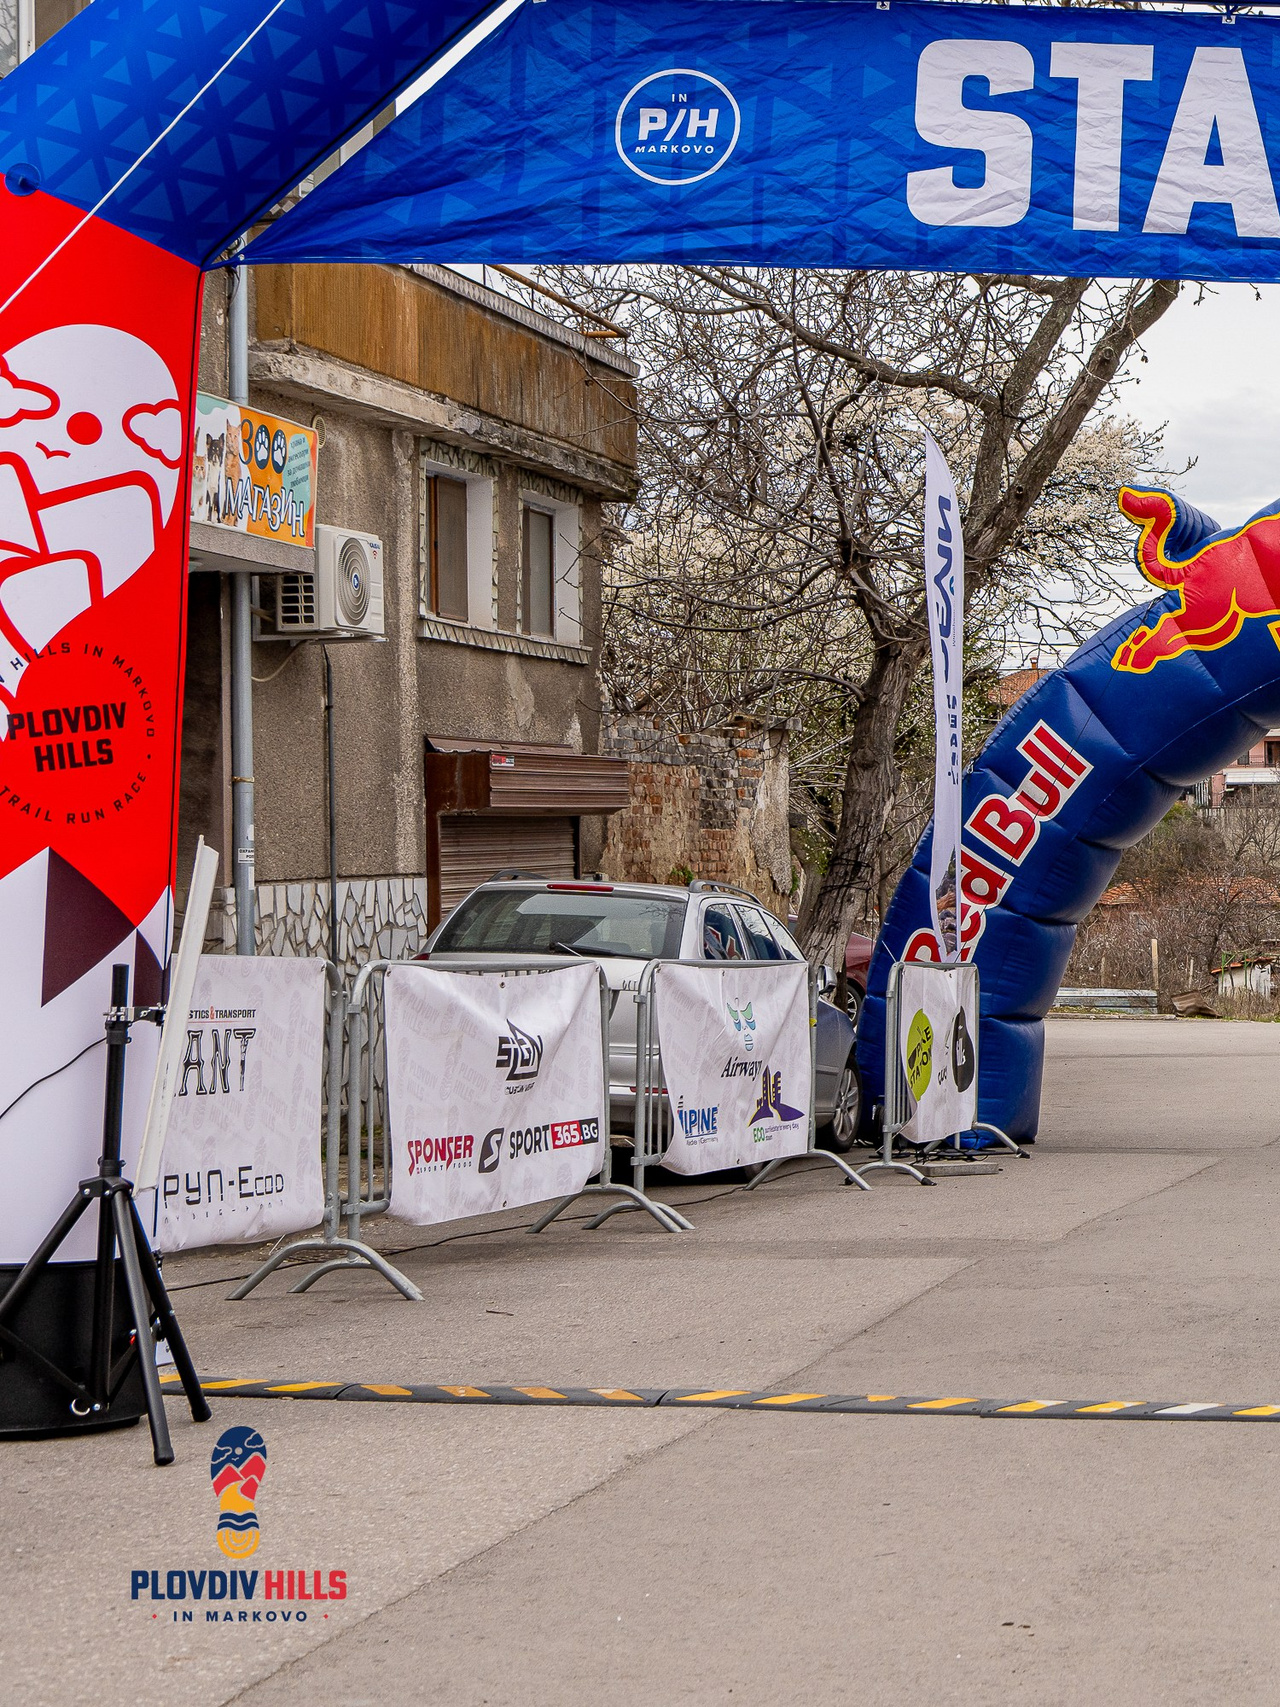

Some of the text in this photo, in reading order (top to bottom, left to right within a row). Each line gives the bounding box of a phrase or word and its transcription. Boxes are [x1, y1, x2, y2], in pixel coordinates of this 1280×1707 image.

[672, 94, 687, 103] IN
[638, 108, 719, 142] P/H
[635, 144, 715, 154] MARKOVO
[225, 477, 305, 538] МАГАЗИН
[10, 642, 155, 737] HILLS IN MARKOVO
[7, 702, 126, 740] PLOVDIV
[34, 738, 114, 772] HILLS
[0, 772, 146, 824] TRAIL RUN RACE
[970, 726, 1086, 860] Bull
[179, 1028, 256, 1096] ANT
[408, 1135, 474, 1176] SPONSER
